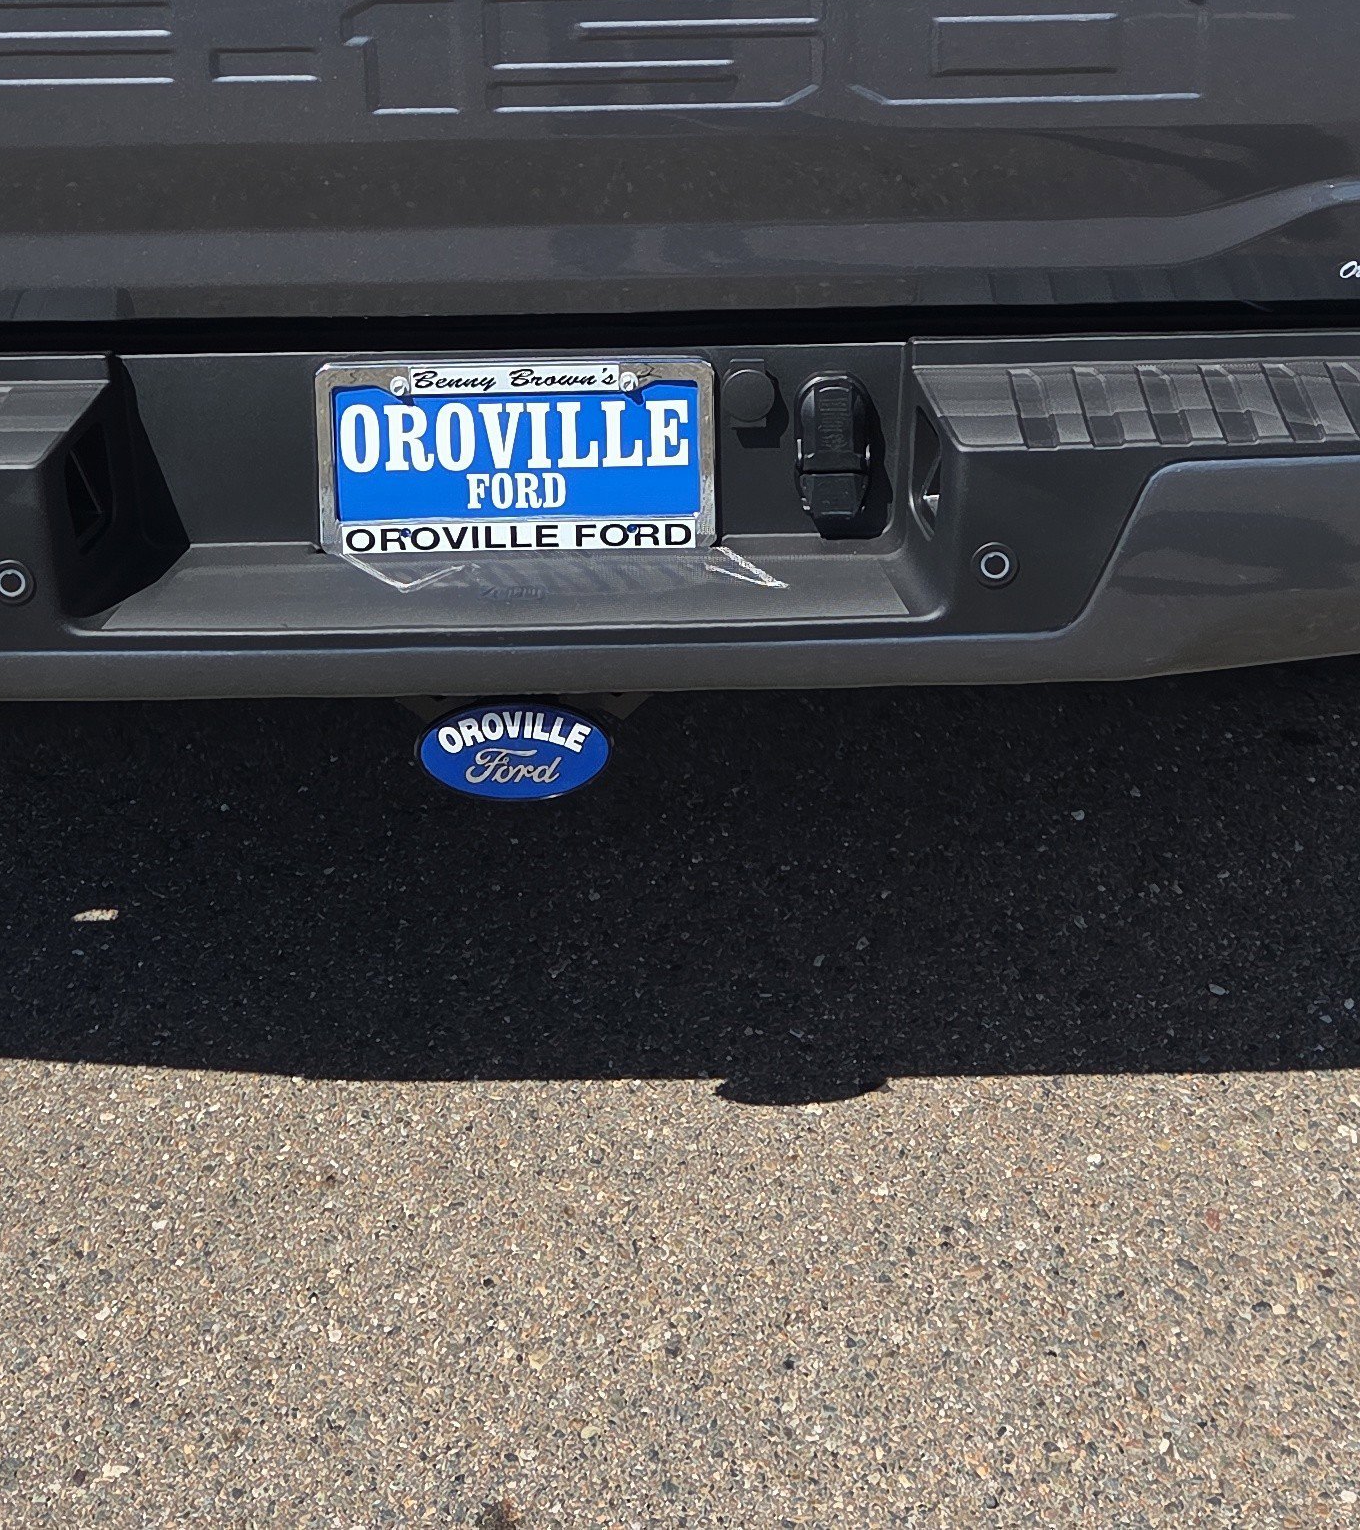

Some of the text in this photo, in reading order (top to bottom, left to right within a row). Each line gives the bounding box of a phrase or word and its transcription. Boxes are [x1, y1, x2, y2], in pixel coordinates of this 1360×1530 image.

[412, 368, 618, 391] Benny Brown's
[340, 399, 689, 473] OROVILLE
[466, 472, 567, 510] FORD
[345, 523, 693, 553] OROVILLE FORD
[437, 710, 592, 754] OROVILLE
[465, 747, 563, 784] Ford
